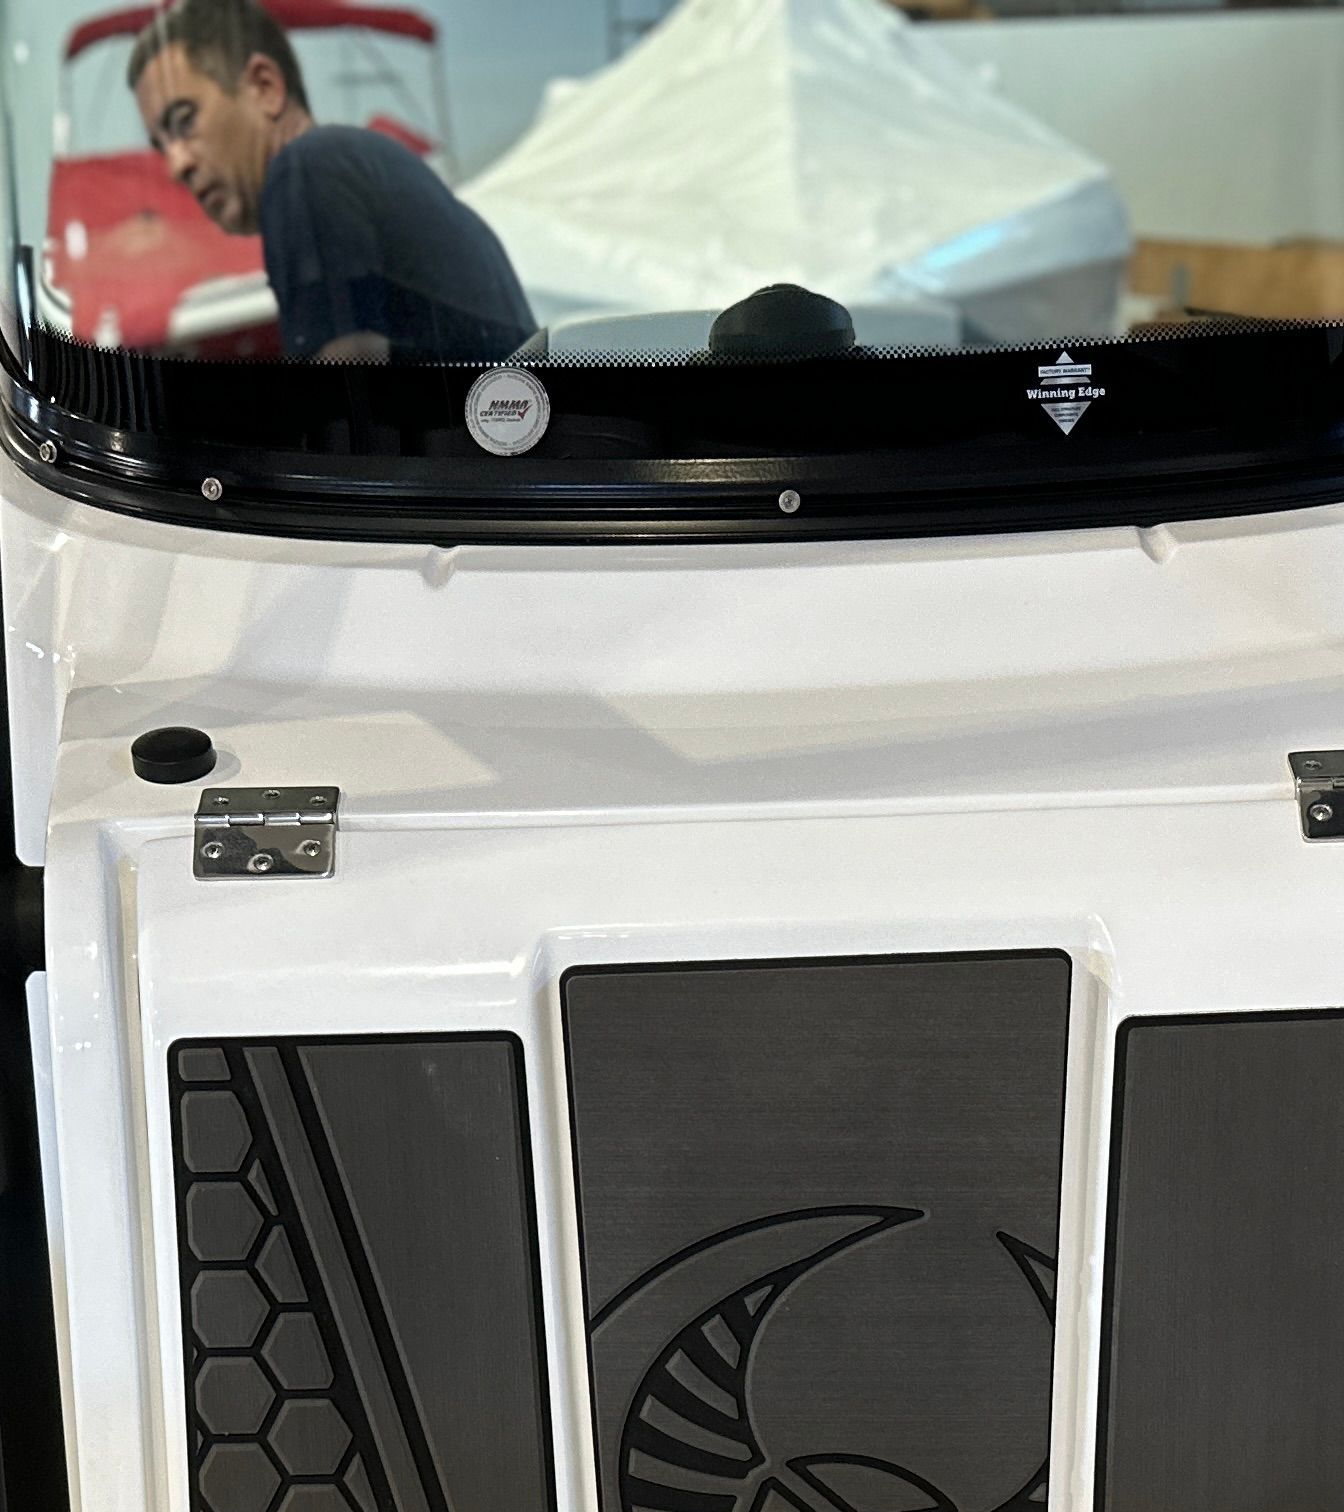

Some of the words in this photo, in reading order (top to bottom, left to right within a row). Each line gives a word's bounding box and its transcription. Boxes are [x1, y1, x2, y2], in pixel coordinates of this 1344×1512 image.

[1026, 387, 1076, 400] Winning
[1078, 386, 1106, 399] Edge
[489, 400, 529, 411] NMMA
